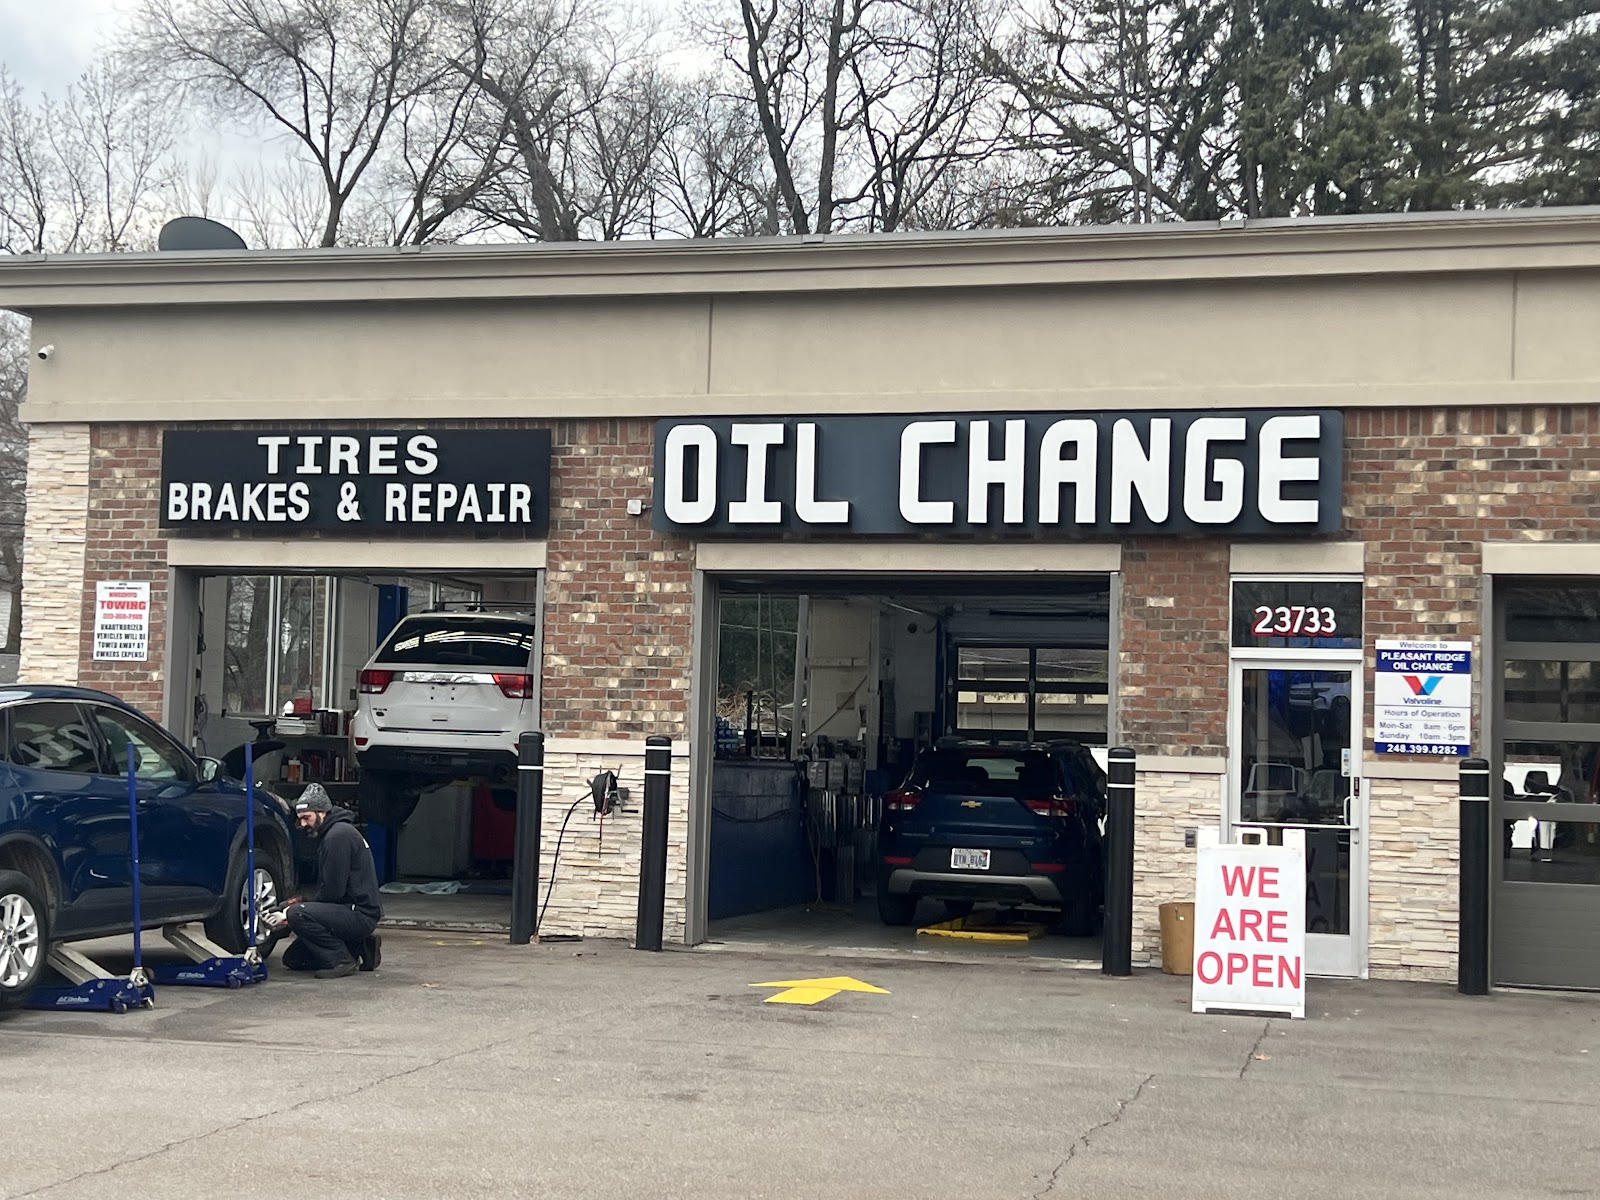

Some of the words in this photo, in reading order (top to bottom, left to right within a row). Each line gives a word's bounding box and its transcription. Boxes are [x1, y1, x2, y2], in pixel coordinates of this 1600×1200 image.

[257, 435, 438, 475] TIRES
[665, 422, 849, 524] OIL
[900, 416, 1321, 524] CHANGE
[168, 482, 310, 522] BRAKES
[337, 482, 361, 522] &
[385, 482, 532, 523] REPAIR
[100, 601, 147, 610] TOWING
[1253, 605, 1338, 636] 23733
[1381, 652, 1433, 661] PLEASANT
[1434, 653, 1466, 662] RIDGE
[1392, 662, 1410, 670] OIL
[1411, 662, 1454, 671] CHANGE
[1402, 697, 1442, 705] Valvoline
[1384, 709, 1408, 717] Hours
[1410, 709, 1419, 717] of
[1420, 710, 1461, 718] Operation
[1379, 721, 1413, 729] Mon-Sat
[1379, 732, 1410, 740] Sunday
[1386, 743, 1458, 755] 248.399.8282
[1221, 865, 1279, 899] WE
[1210, 907, 1288, 943] ARE
[1196, 951, 1301, 989] OPEN
